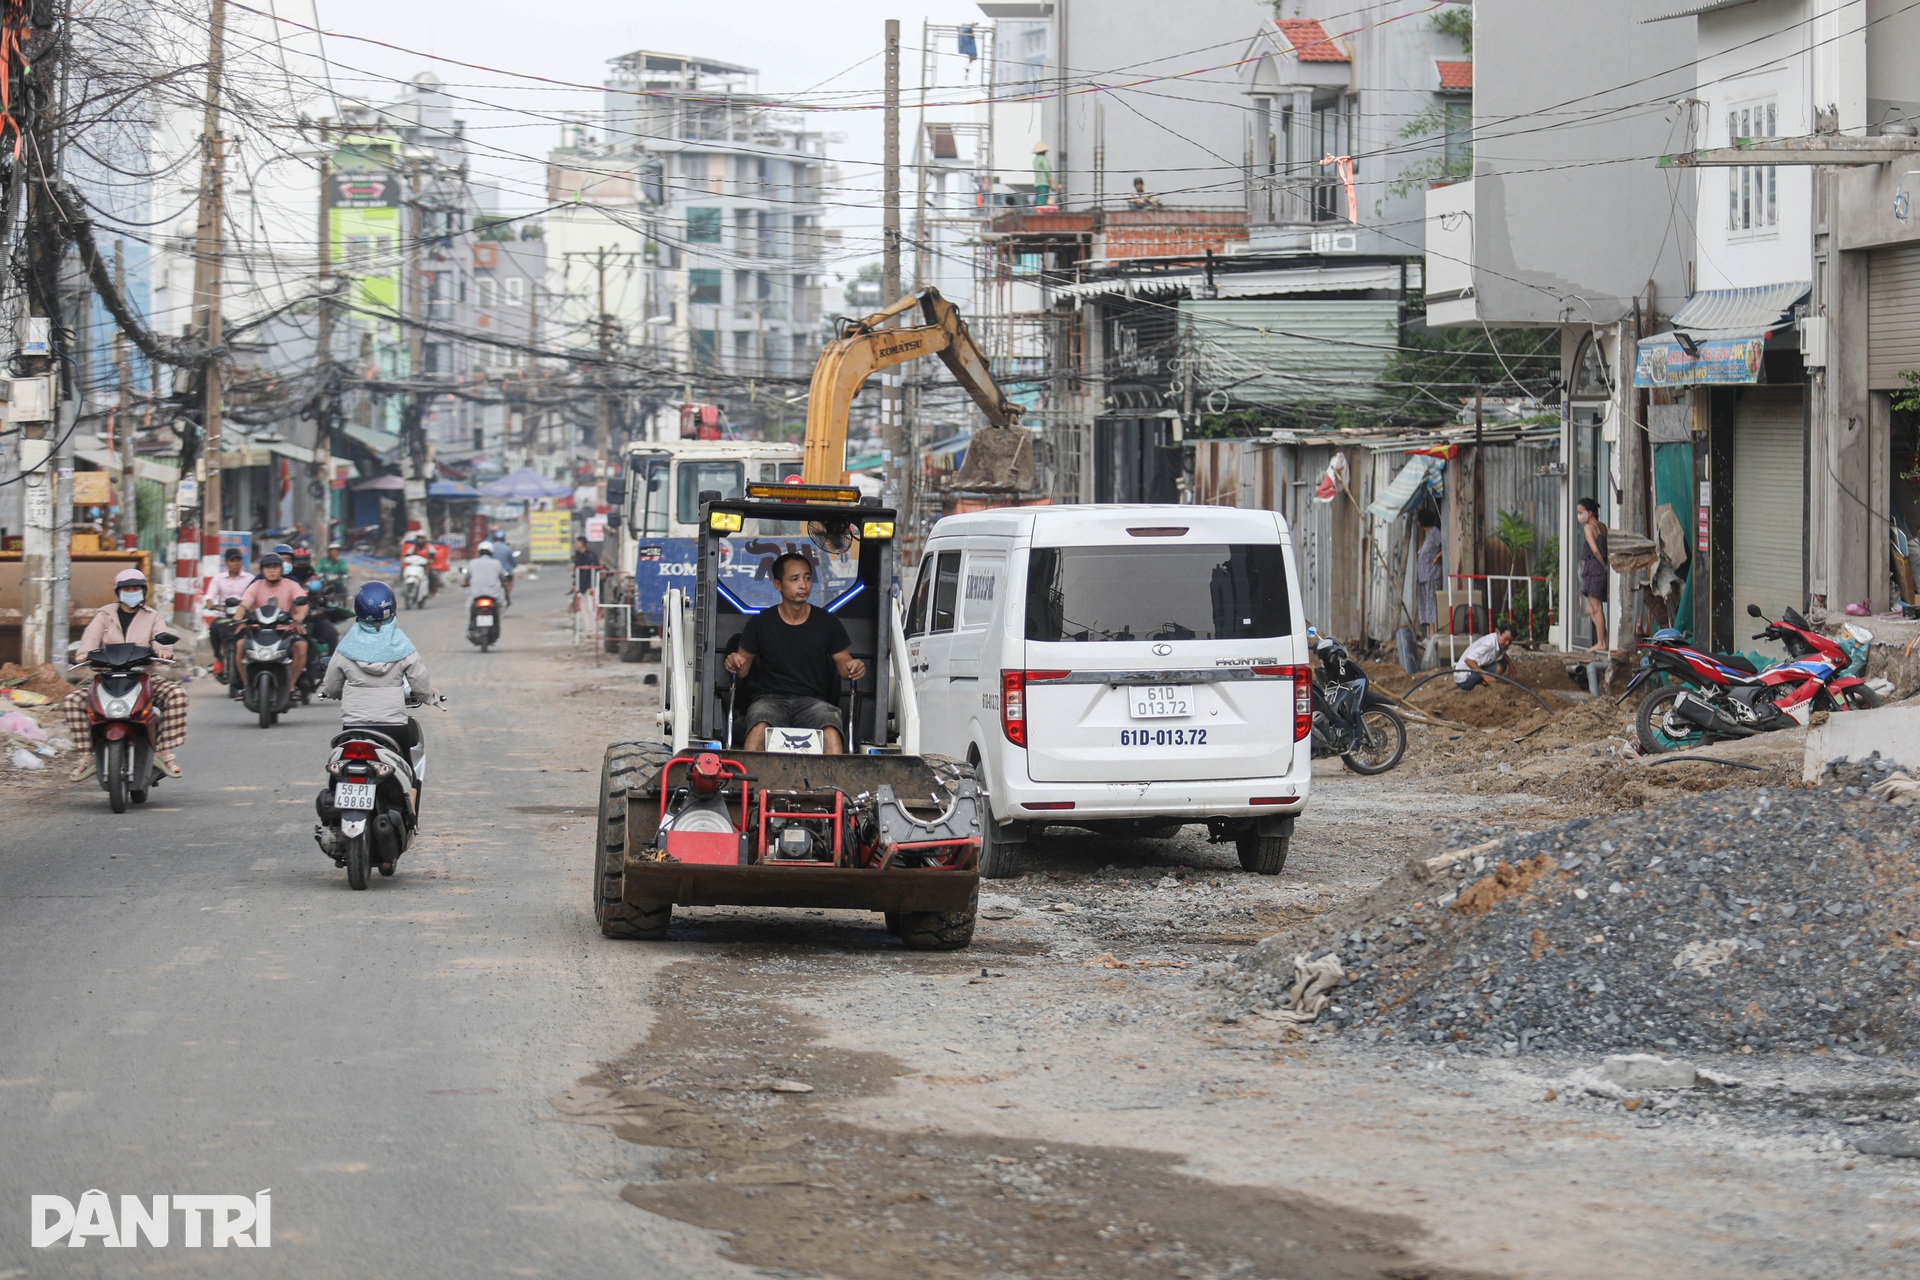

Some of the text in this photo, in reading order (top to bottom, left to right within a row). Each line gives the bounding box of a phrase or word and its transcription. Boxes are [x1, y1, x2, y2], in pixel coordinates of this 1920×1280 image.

[879, 340, 922, 357] KOMATSU
[1215, 656, 1278, 667] FRONTIER
[1148, 687, 1175, 700] 61D
[1138, 701, 1187, 715] 013.72
[1785, 700, 1811, 714] HONDA
[1120, 729, 1207, 746] 61D-013.72
[342, 784, 369, 796] 59-P1
[337, 795, 373, 808] 498.69
